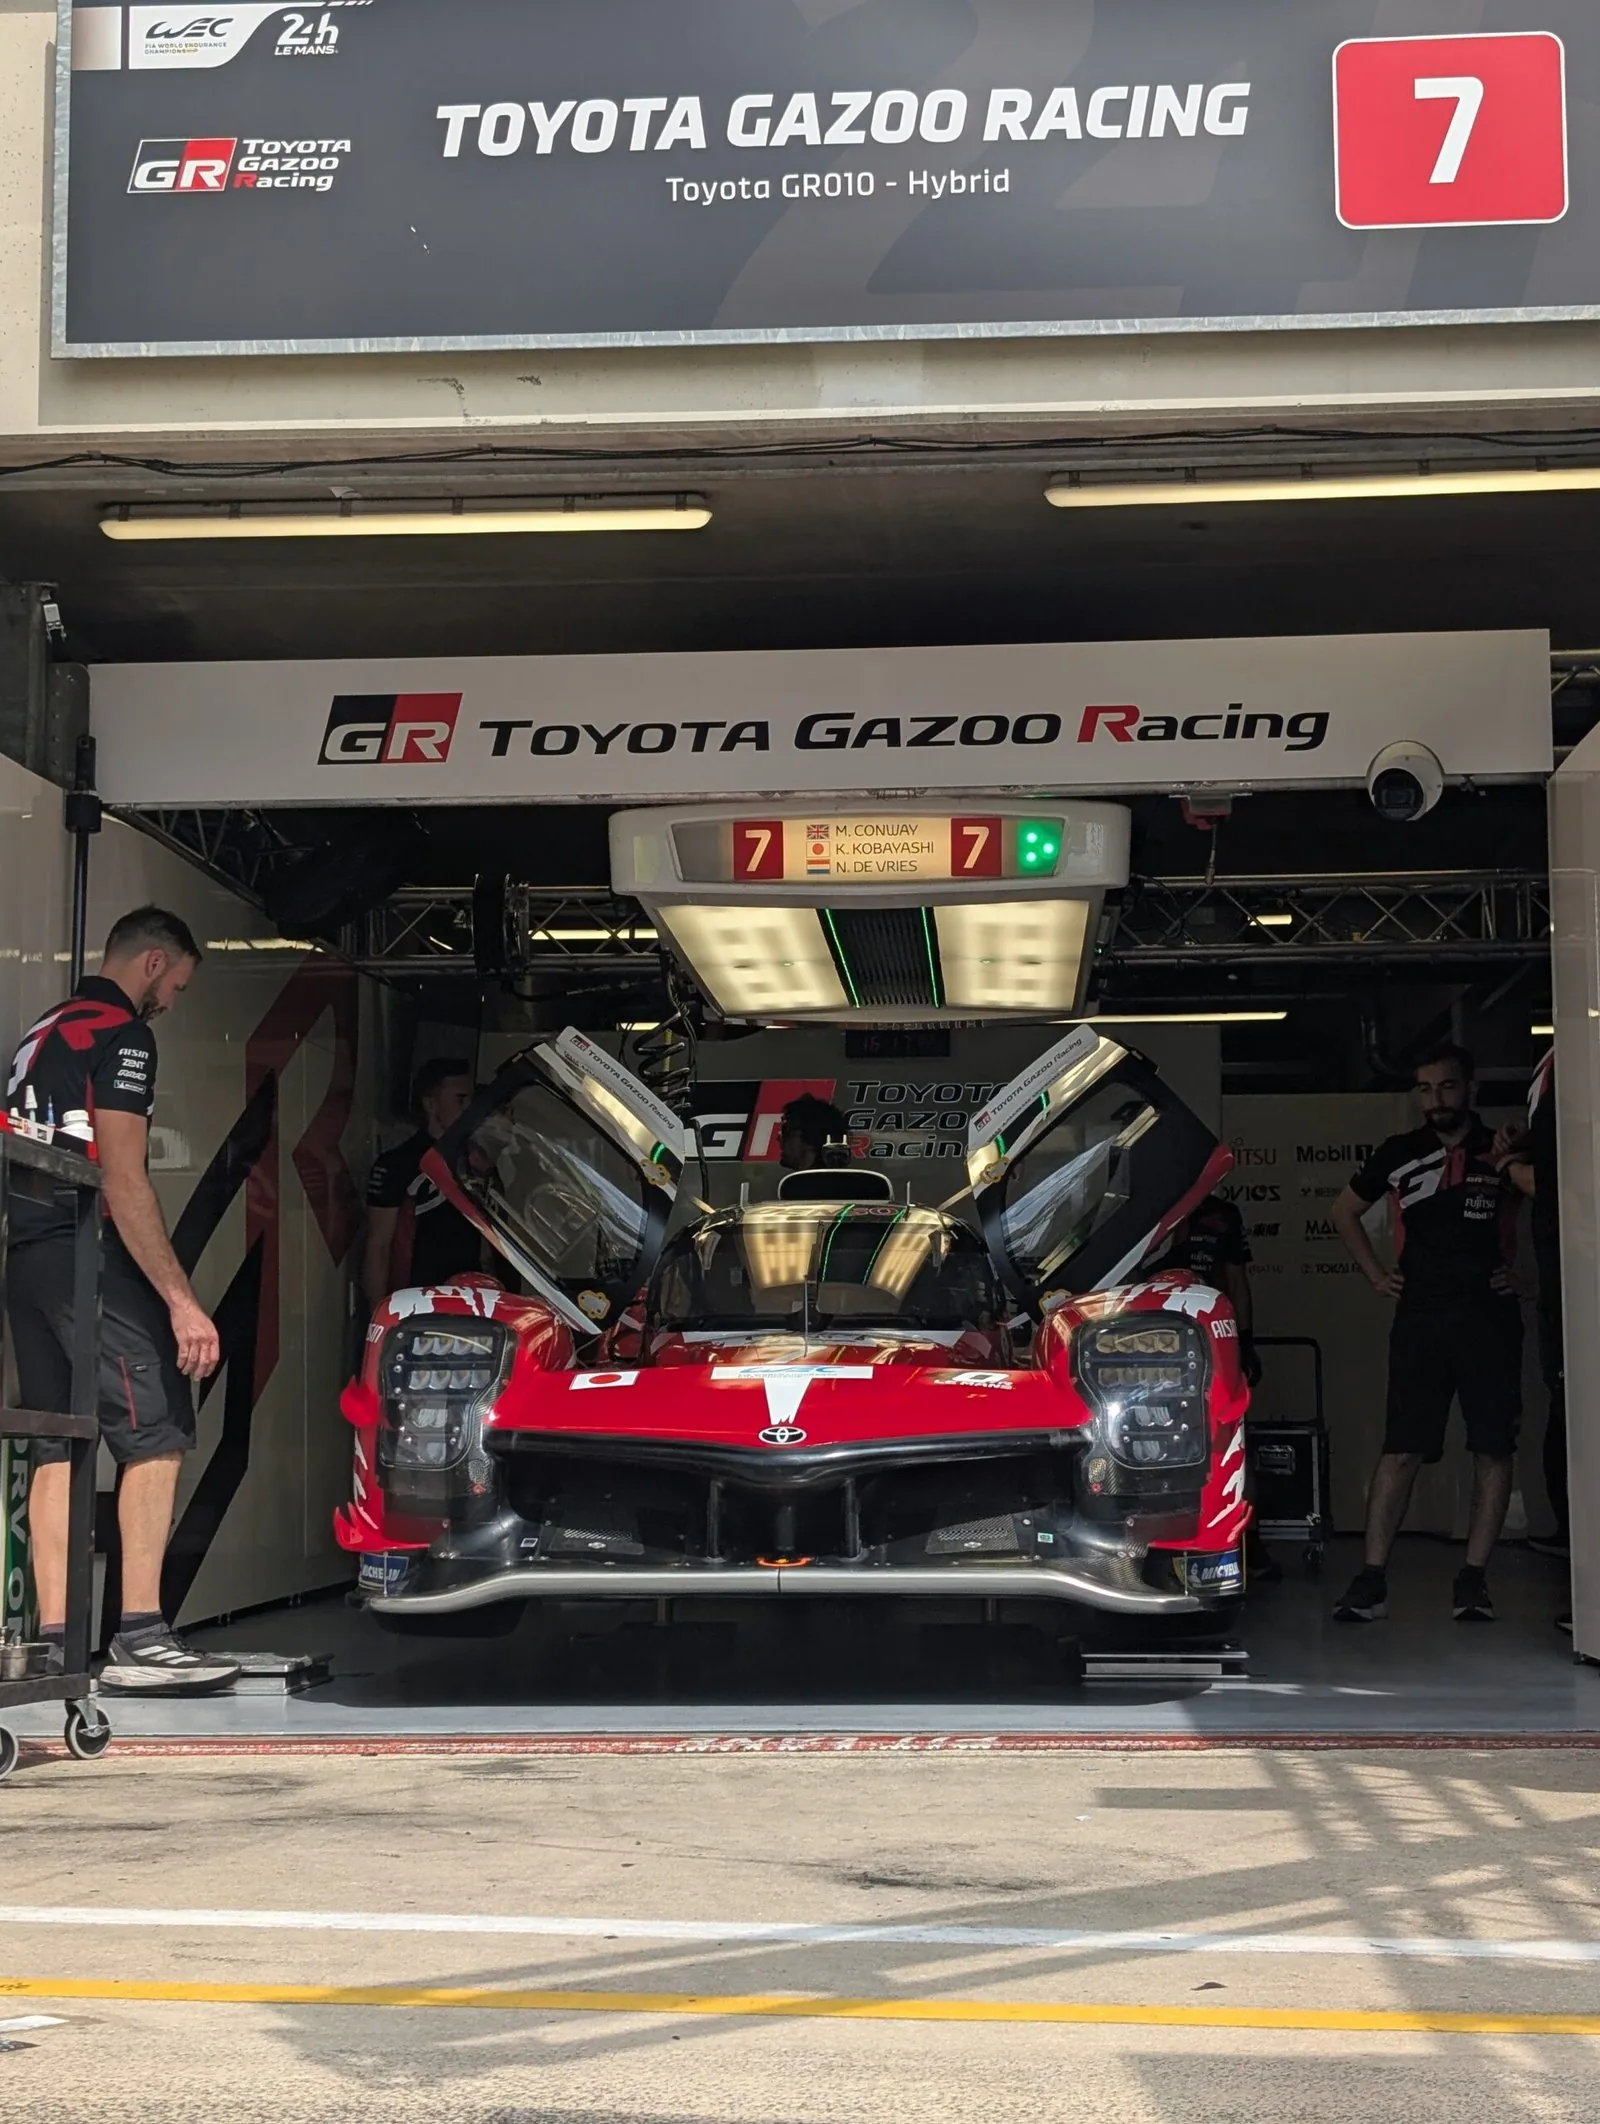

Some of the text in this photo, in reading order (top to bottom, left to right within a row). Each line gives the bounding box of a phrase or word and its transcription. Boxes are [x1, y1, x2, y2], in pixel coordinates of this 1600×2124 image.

[145, 17, 235, 39] WEC
[277, 12, 339, 46] 24h
[184, 41, 228, 49] ENDURANCE
[274, 45, 335, 56] LE MANS
[435, 82, 1251, 158] TOYOTA GAZOO RACING
[1414, 76, 1485, 184] 7
[242, 138, 351, 155] TOYOTA
[133, 159, 226, 189] GR
[237, 156, 339, 171] GAZOO
[233, 172, 334, 192] Racing
[665, 174, 771, 206] Toyota
[780, 169, 875, 200] GR010
[908, 168, 1010, 198] Hybrid
[323, 703, 1331, 762] GR TOYOTA GAZOO Racing
[835, 824, 919, 837] M. CONWAY
[741, 829, 773, 872] 7
[835, 841, 934, 855] K. KOBAYASHI
[962, 826, 990, 869] 7
[835, 860, 918, 874] N. DE VRIES
[118, 1048, 149, 1060] AISIN
[991, 1086, 1024, 1116] TOYOTA
[1023, 1061, 1053, 1088] GAZOO
[1053, 1038, 1083, 1063] Racing
[588, 1049, 621, 1079] TOYOTA
[620, 1077, 649, 1105] GAZOO
[648, 1103, 676, 1130] Racing
[1296, 1144, 1351, 1163] Mobil
